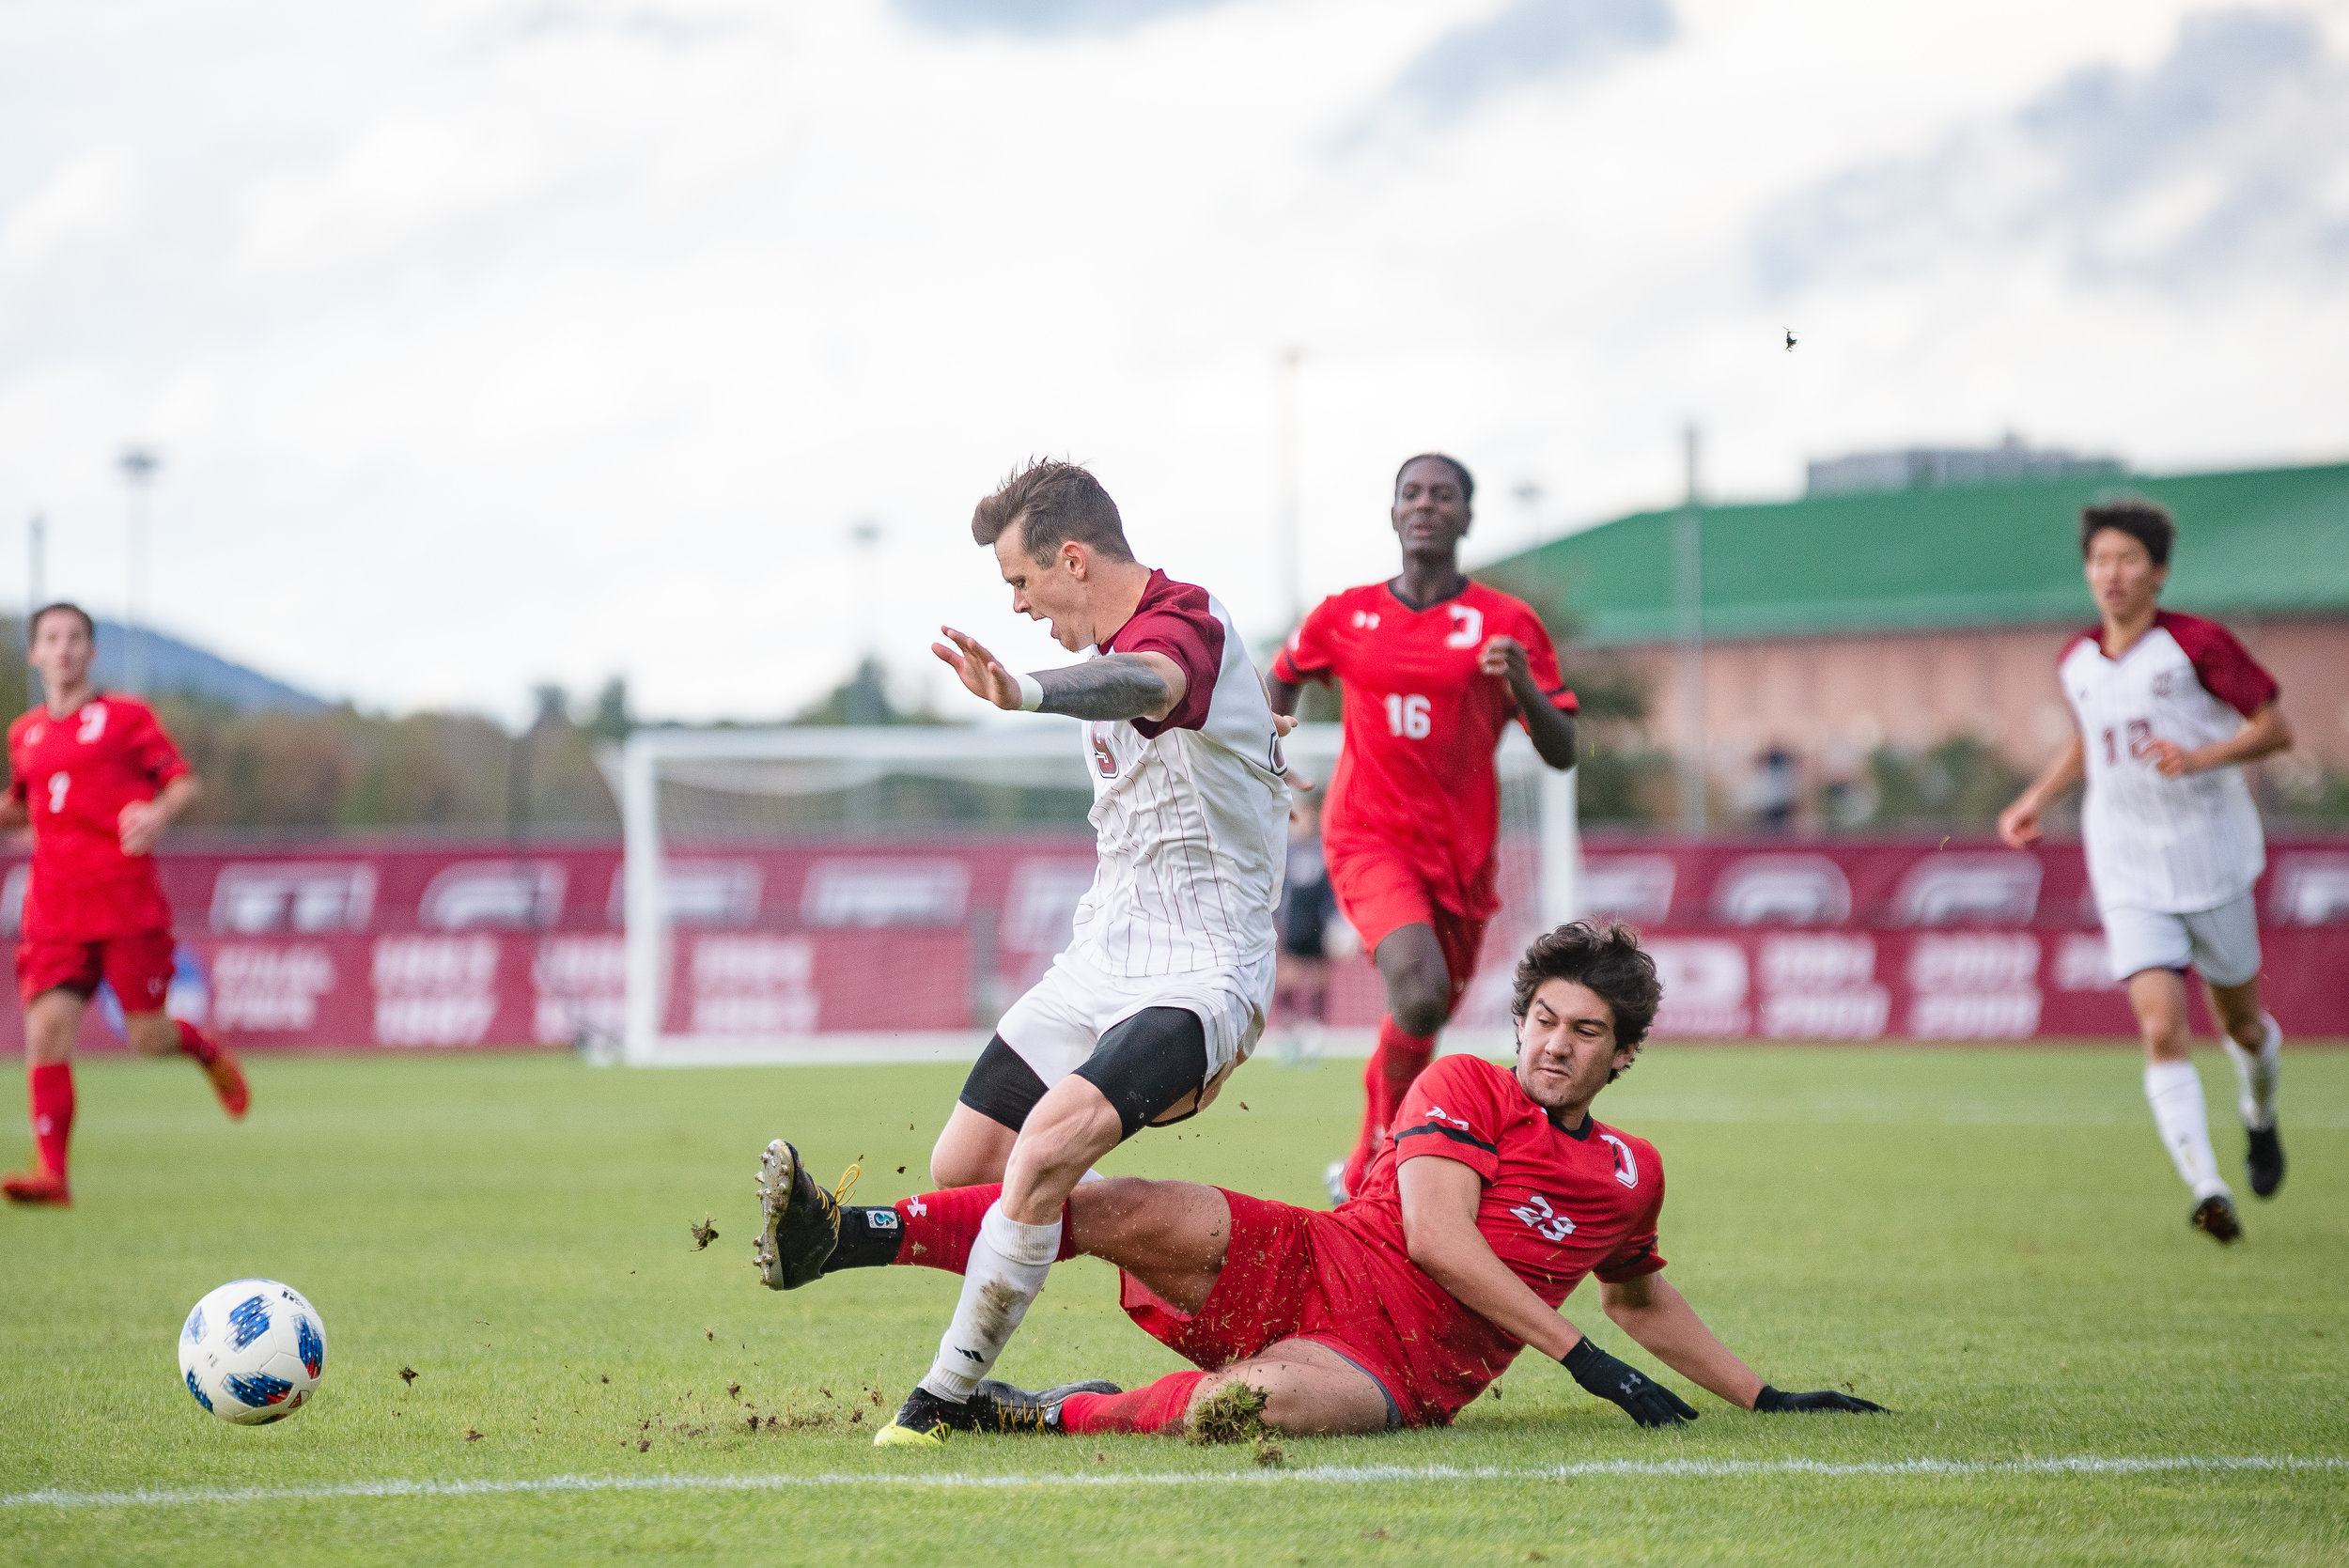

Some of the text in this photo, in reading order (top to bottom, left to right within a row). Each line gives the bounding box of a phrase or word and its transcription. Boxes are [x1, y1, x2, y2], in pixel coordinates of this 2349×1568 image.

[1385, 692, 1433, 740] 16
[2104, 718, 2153, 767] 12
[1509, 1194, 1577, 1242] 23
